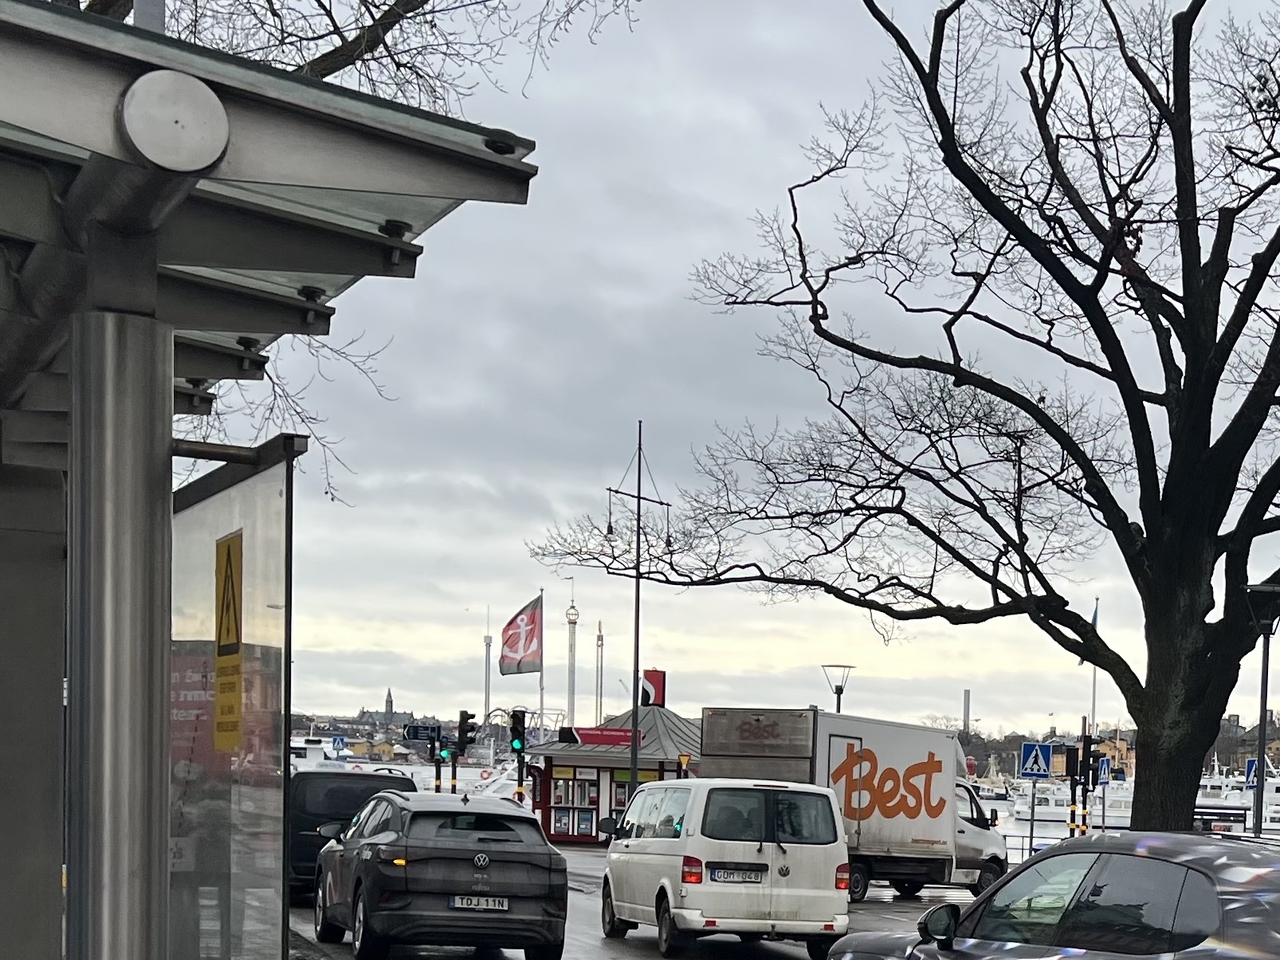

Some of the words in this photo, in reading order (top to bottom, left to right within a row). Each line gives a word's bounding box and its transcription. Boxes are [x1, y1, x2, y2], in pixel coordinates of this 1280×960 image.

[735, 720, 780, 741] Best
[830, 742, 947, 822] Best
[458, 896, 480, 907] TDJ
[484, 898, 505, 909] 11N
